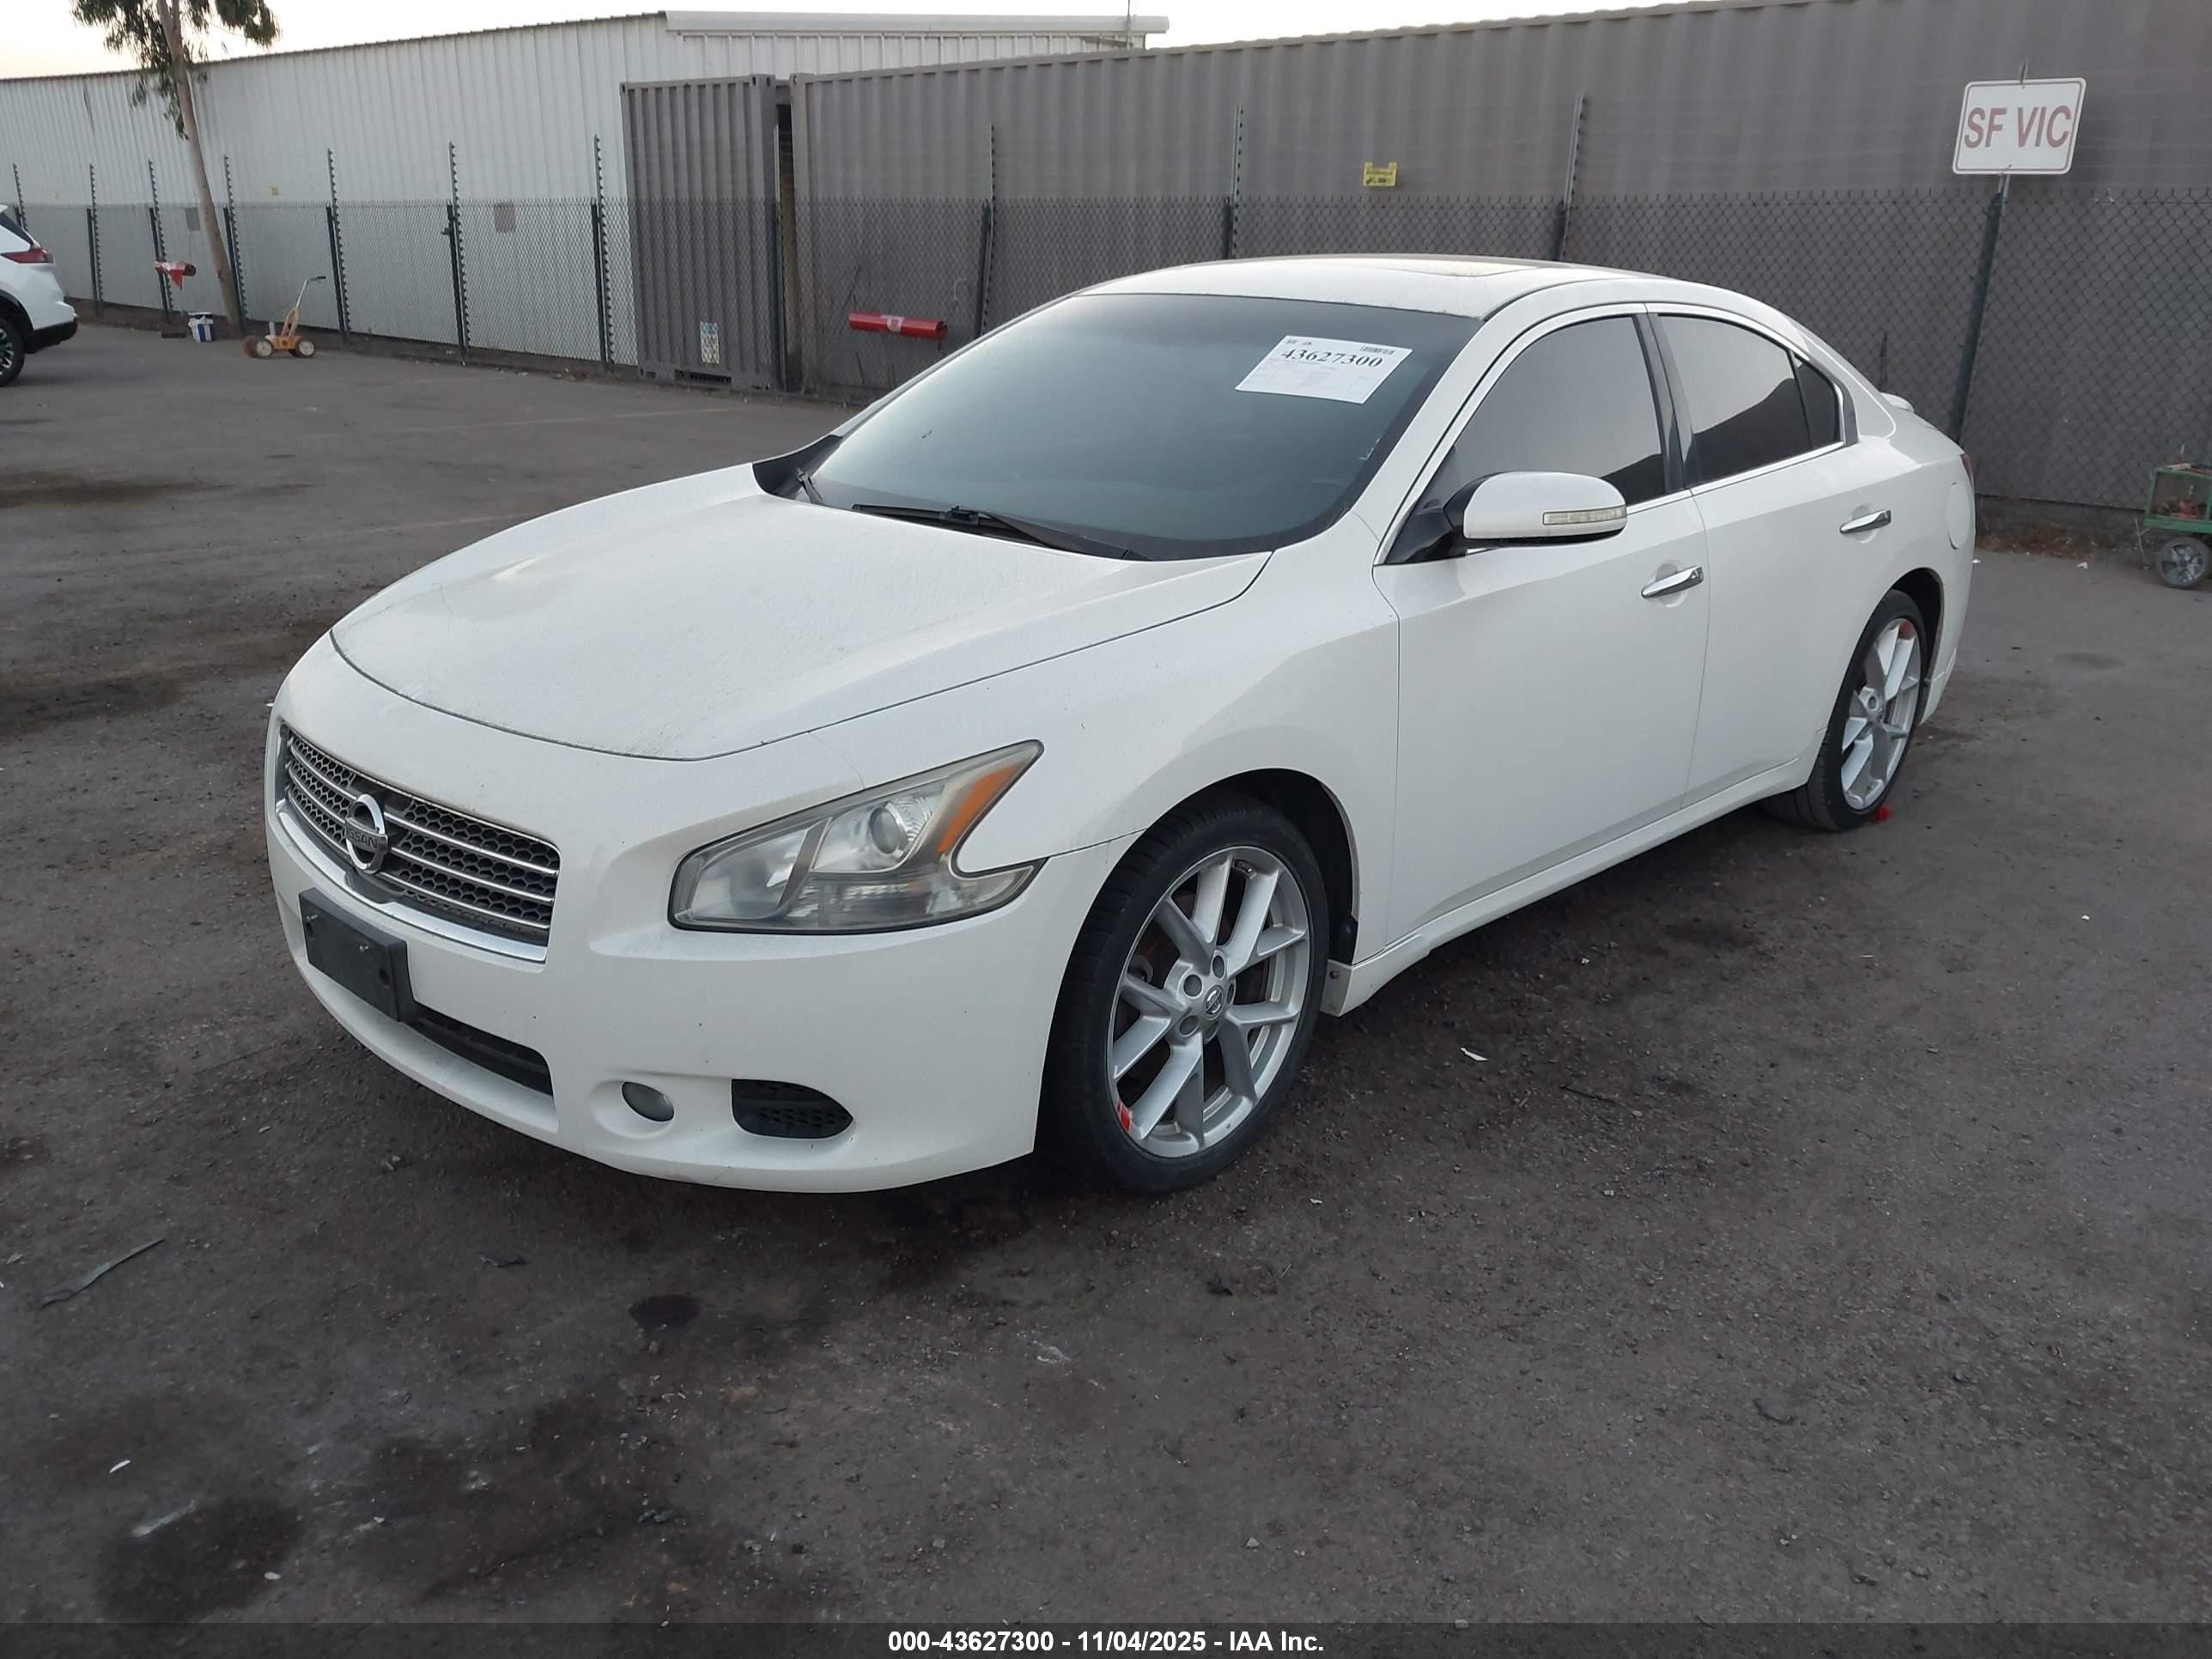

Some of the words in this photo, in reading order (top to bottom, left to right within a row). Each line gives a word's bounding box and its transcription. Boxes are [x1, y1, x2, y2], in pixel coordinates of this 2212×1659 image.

[1964, 107, 2008, 149] SF
[2017, 105, 2072, 148] VIC
[1280, 348, 1383, 368] 43627300
